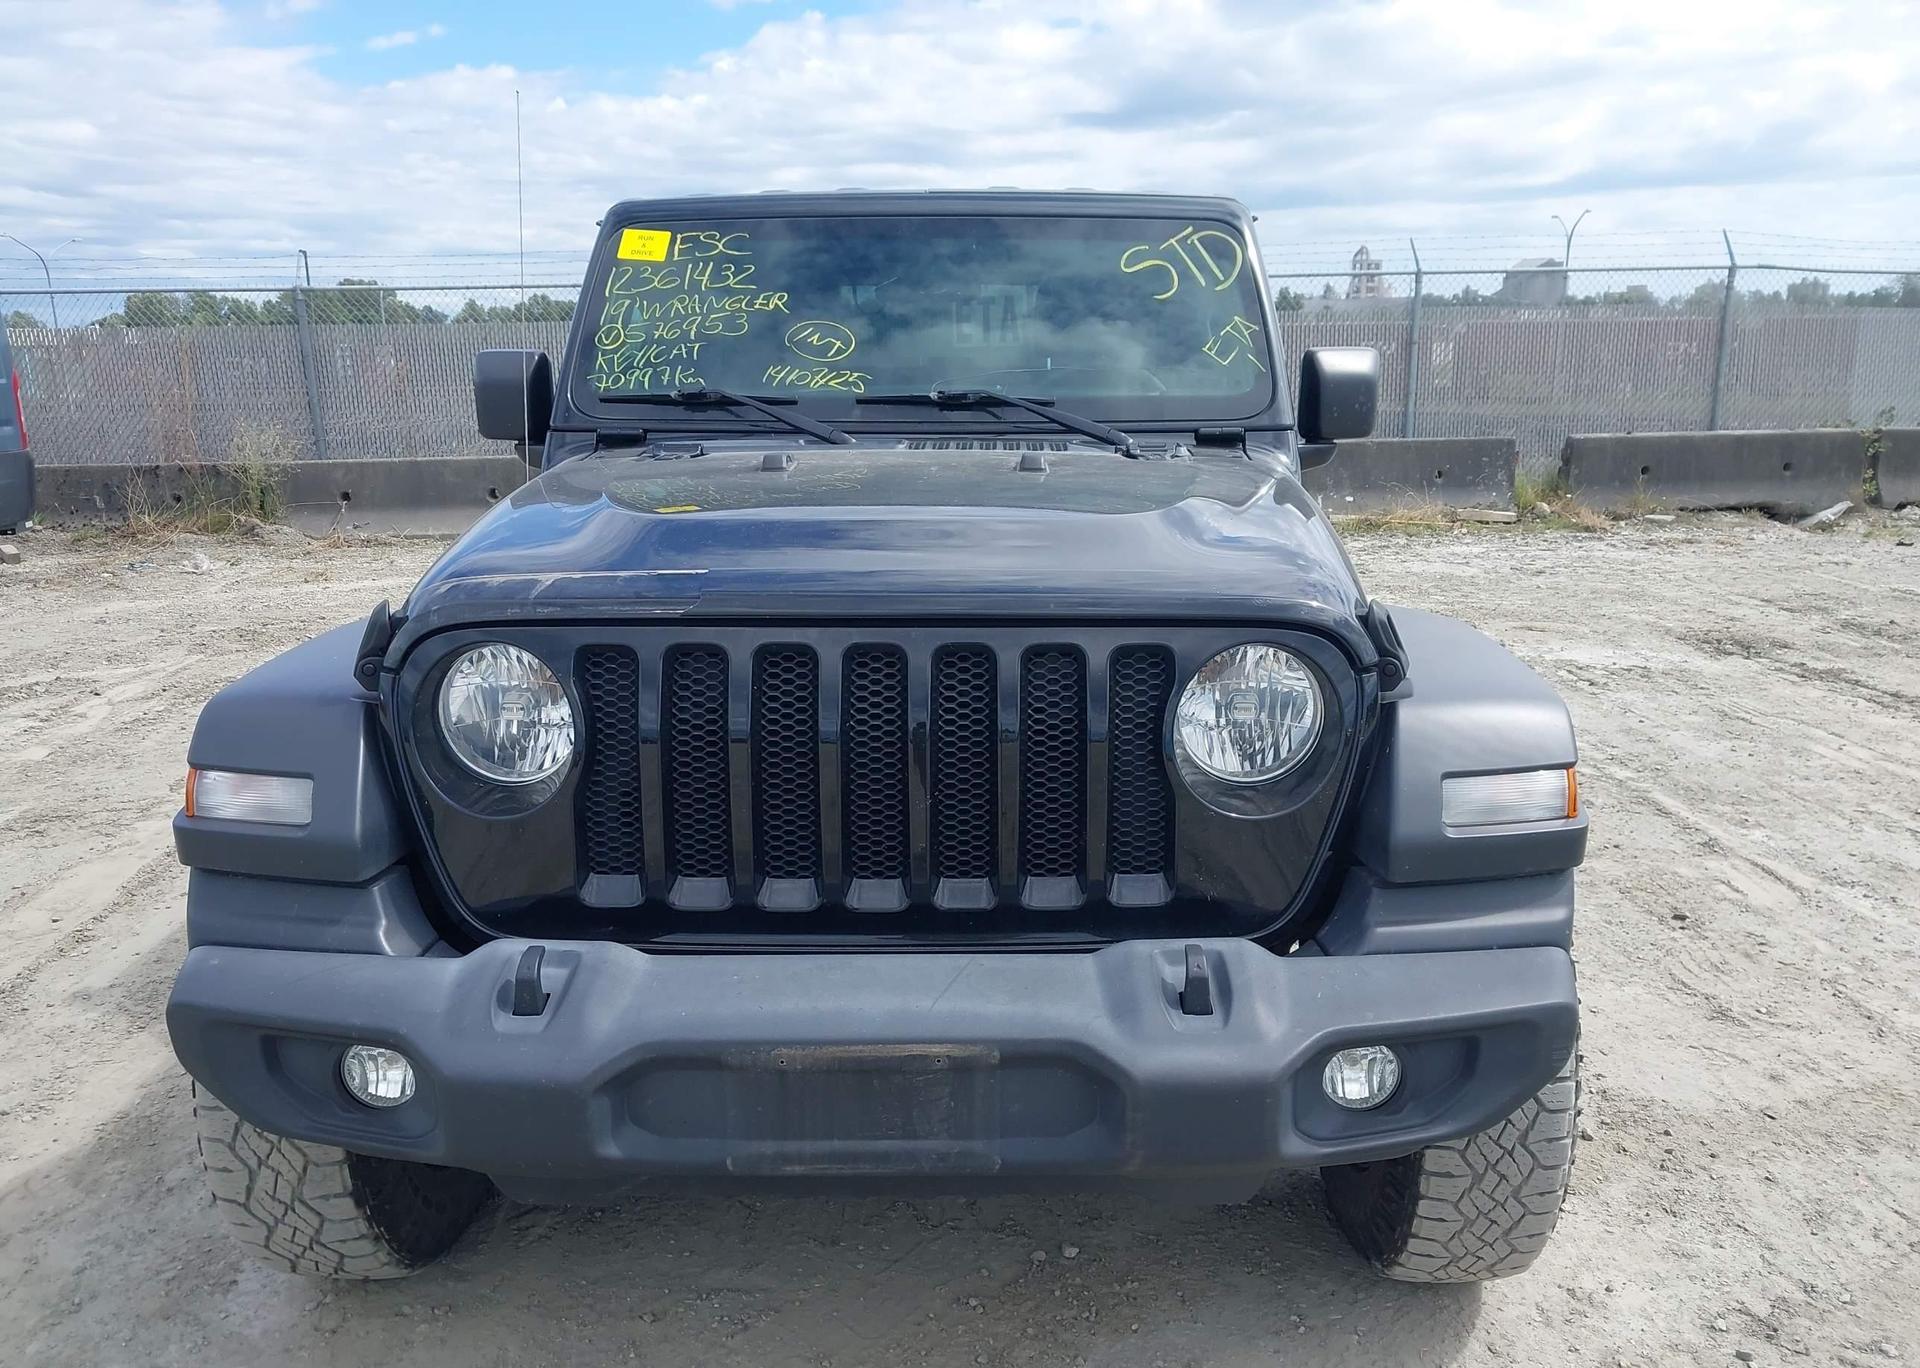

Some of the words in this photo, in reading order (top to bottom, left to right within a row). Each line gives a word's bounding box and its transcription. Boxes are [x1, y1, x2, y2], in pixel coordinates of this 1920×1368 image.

[630, 249, 655, 257] DRIVE
[637, 234, 655, 242] RUN
[672, 231, 752, 261] ESC
[1120, 226, 1243, 300] STD
[605, 262, 757, 297] 12361432
